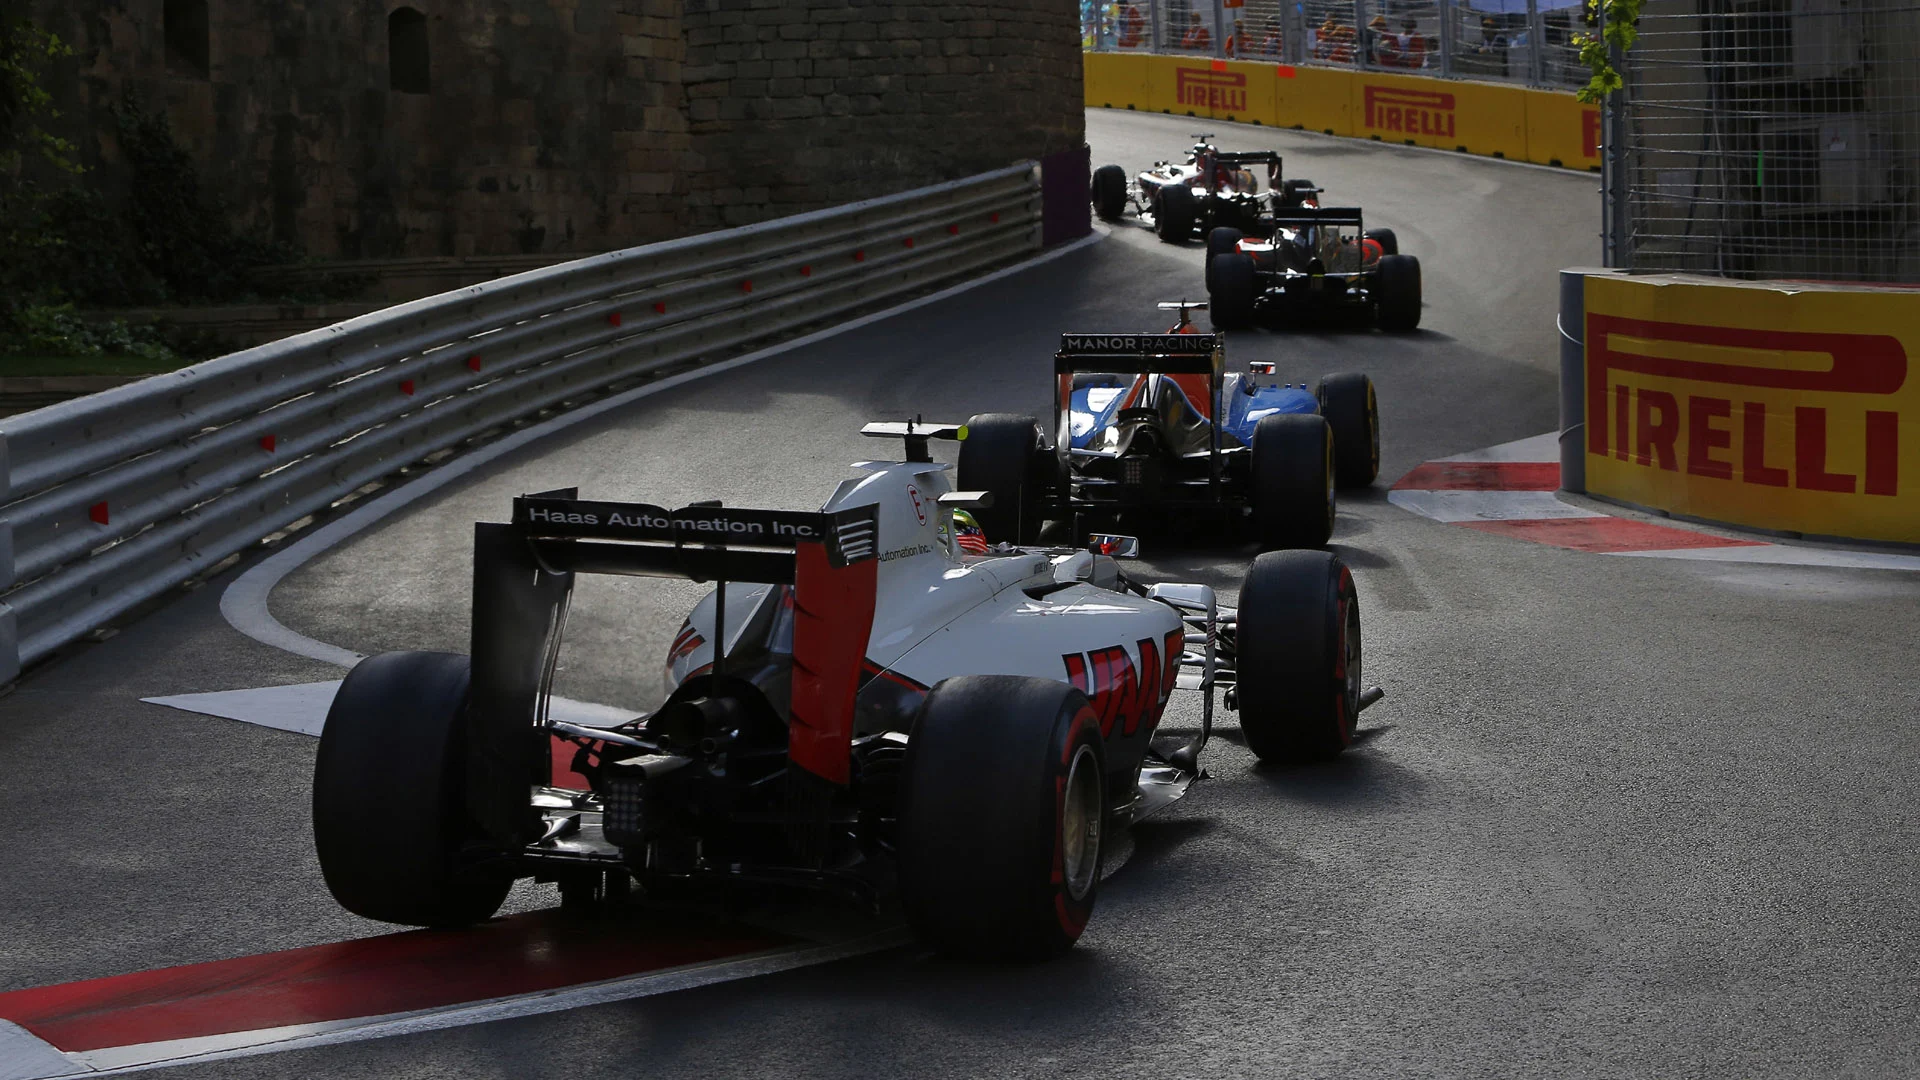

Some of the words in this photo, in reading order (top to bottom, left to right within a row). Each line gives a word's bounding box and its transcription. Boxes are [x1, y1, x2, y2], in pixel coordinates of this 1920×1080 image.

[1176, 67, 1246, 111] PIRELLI
[1364, 85, 1456, 138] PIRELLI
[1067, 337, 1137, 350] MANOR
[1141, 337, 1212, 350] RACING
[1586, 312, 1908, 497] PIRELLI
[529, 507, 599, 525] Haas
[607, 510, 763, 534] Automation
[773, 520, 820, 537] Inc.
[877, 544, 919, 563] Automation
